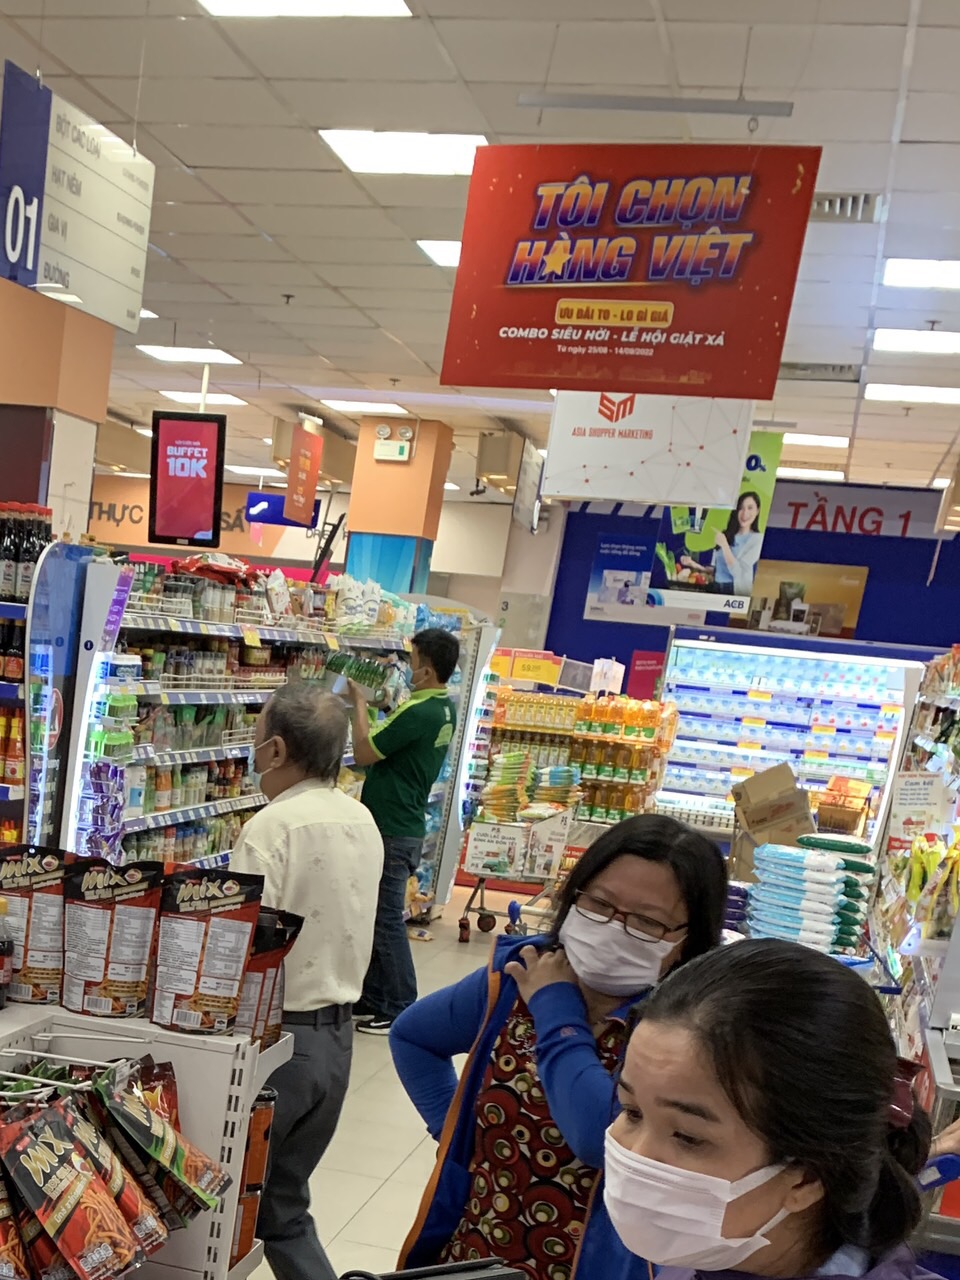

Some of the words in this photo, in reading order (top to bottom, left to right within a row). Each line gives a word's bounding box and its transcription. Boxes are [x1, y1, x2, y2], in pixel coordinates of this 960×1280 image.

[534, 175, 609, 229] TÔI
[615, 175, 752, 230] CHỌN
[5, 185, 38, 271] 01
[507, 232, 637, 284] HÀNG
[648, 226, 754, 285] VIỆT
[597, 308, 610, 321] TO
[499, 327, 549, 339] COMBO
[551, 325, 581, 340] SIÊU
[641, 330, 666, 346] HỘI
[669, 331, 702, 347] GIẶT
[704, 331, 725, 346] XẢ
[572, 427, 587, 437] ASIA
[617, 428, 654, 440] MARKETING
[166, 446, 208, 457] BUFFET
[166, 457, 208, 479] 10K
[745, 454, 767, 474] 0%
[89, 501, 144, 527] THỰC
[787, 491, 885, 537] TẦNG
[898, 509, 913, 539] 1
[501, 601, 509, 611] 3
[723, 599, 745, 610] ACB
